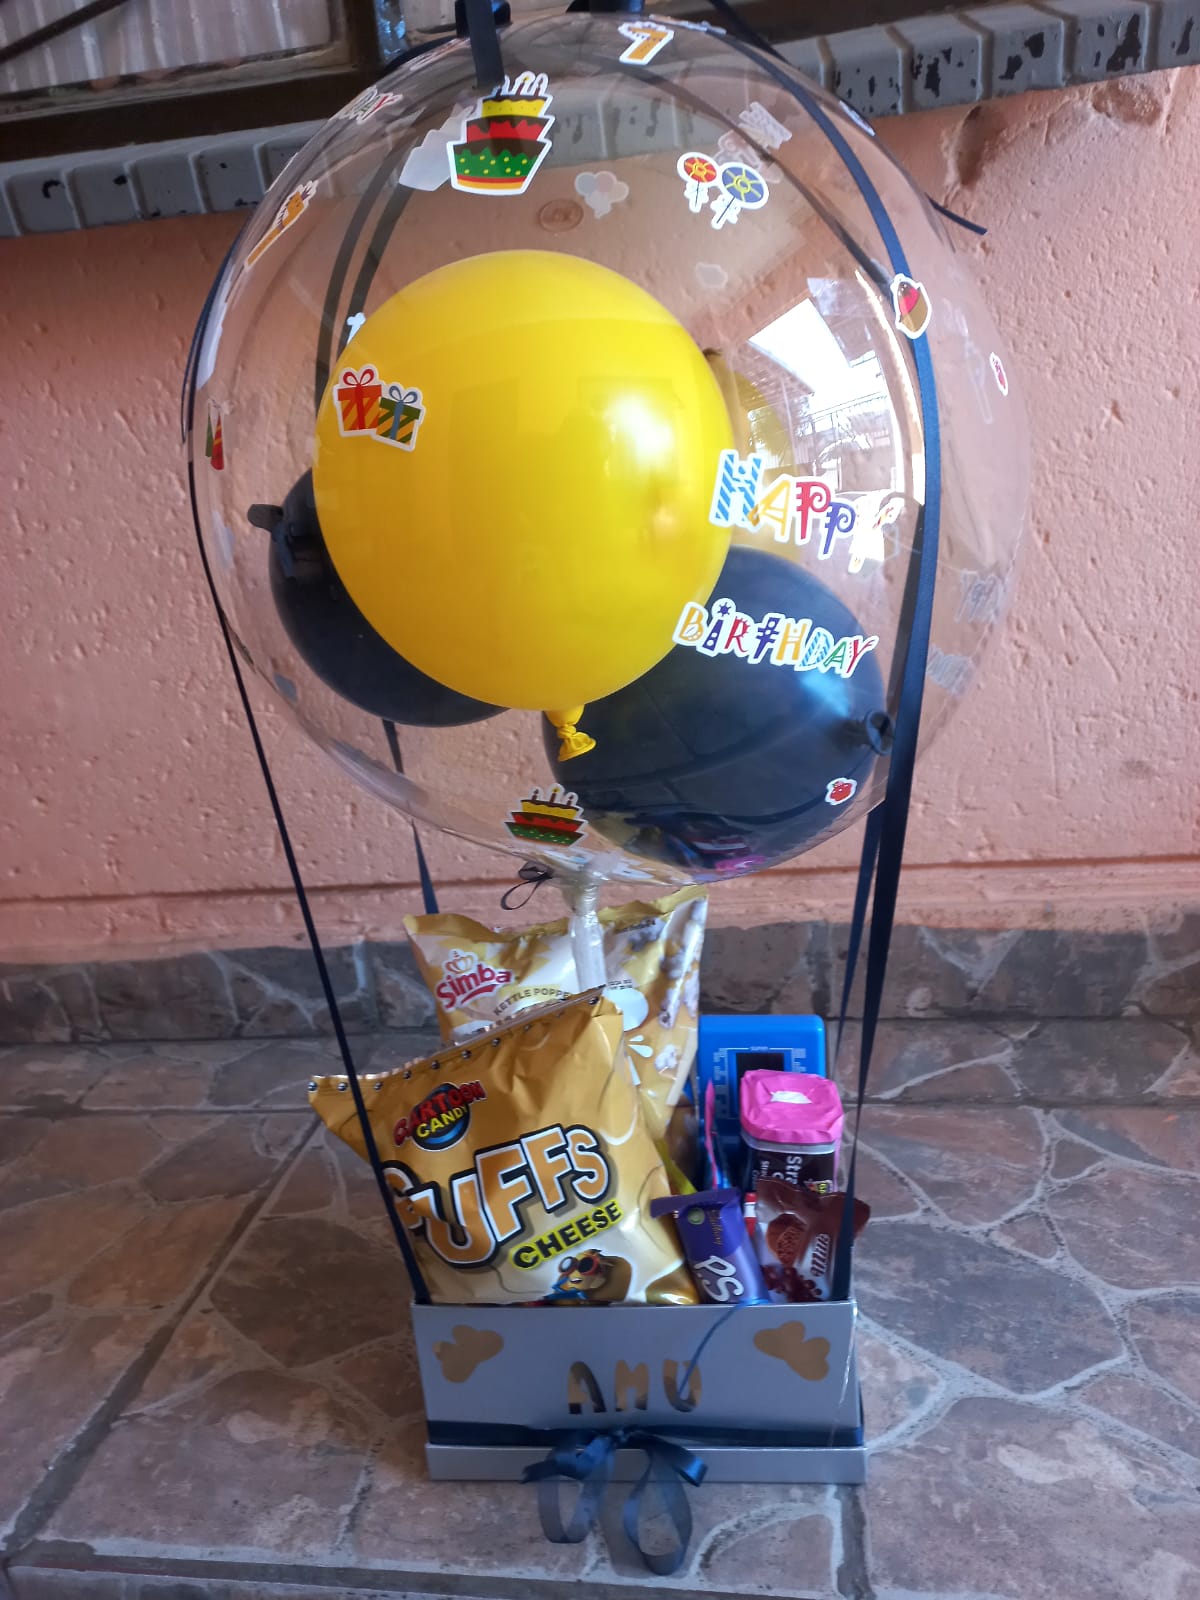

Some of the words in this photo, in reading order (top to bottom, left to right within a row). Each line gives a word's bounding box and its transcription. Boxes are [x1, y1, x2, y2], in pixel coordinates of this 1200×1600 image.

[436, 963, 512, 1009] Simba
[493, 988, 532, 1016] KETTLE
[393, 1081, 486, 1146] CARTOON
[416, 1105, 468, 1138] CANDY
[512, 1200, 622, 1268] CHEESE
